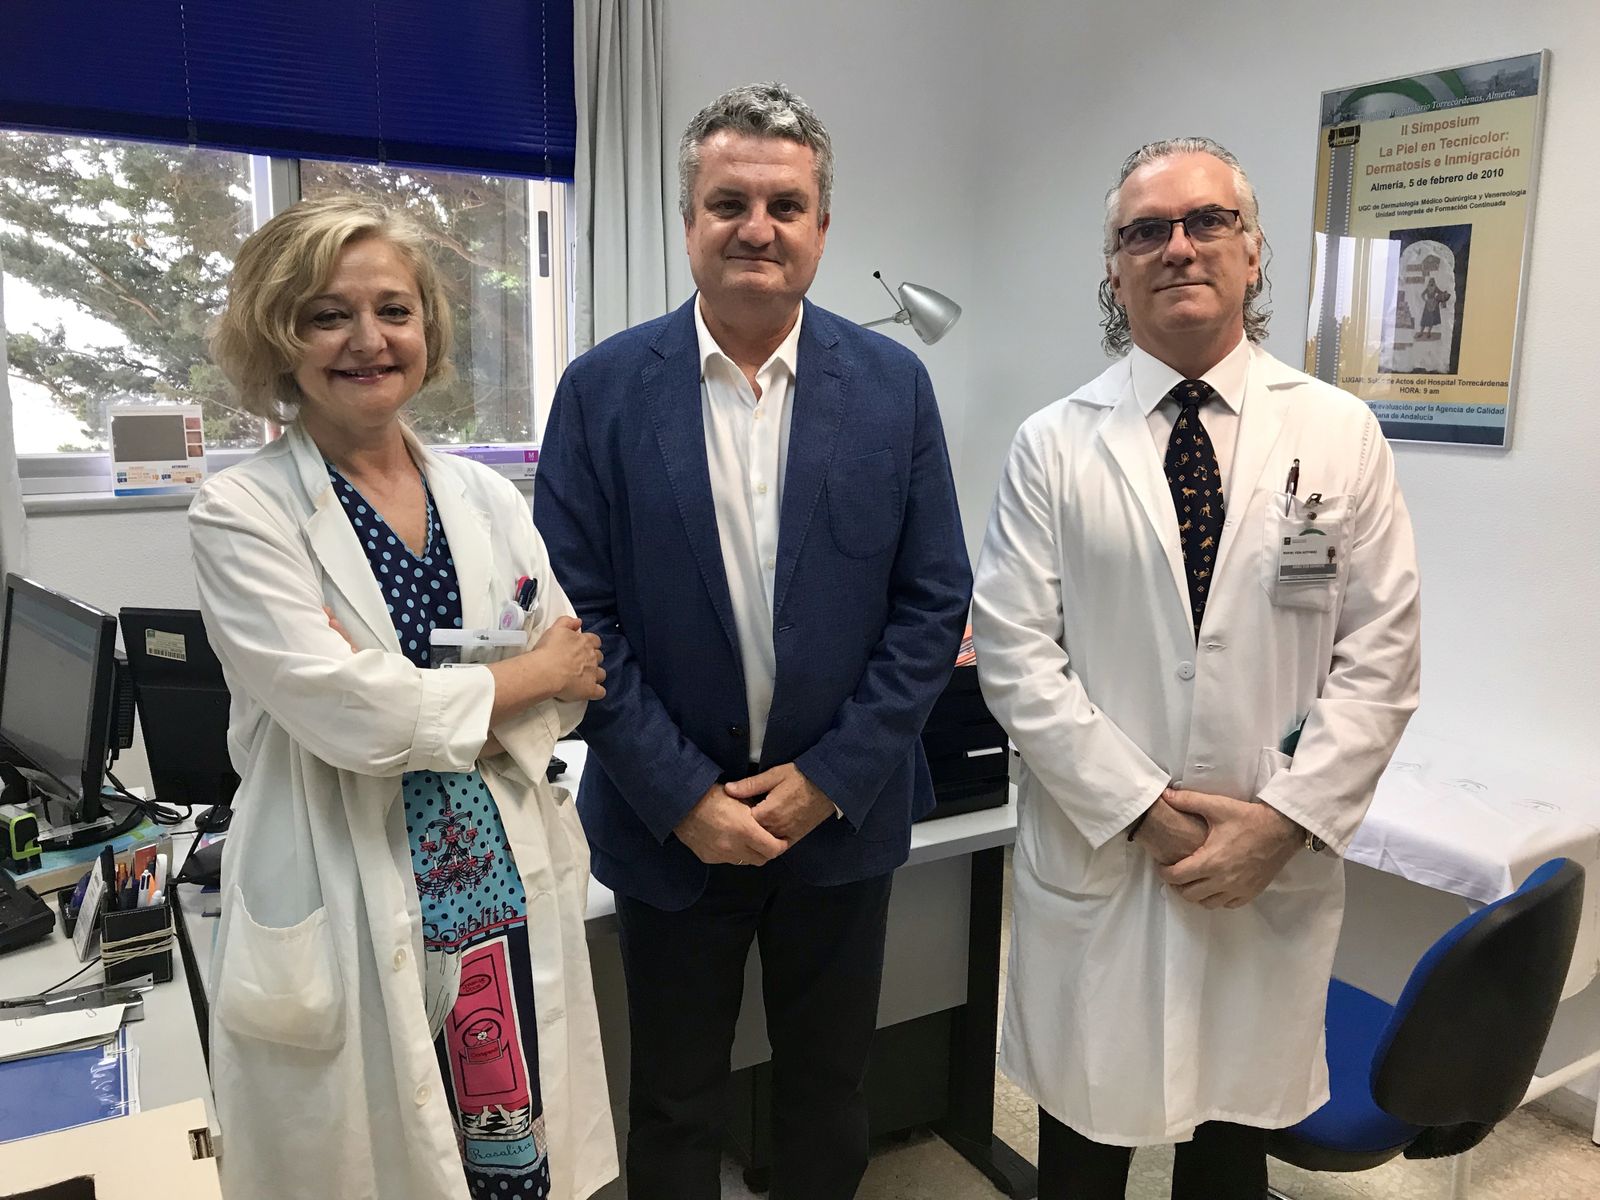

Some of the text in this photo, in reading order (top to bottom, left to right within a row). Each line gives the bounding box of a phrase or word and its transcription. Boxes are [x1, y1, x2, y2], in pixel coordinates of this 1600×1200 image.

[1485, 89, 1516, 101] Almería
[1400, 116, 1480, 136] II Simposium
[1379, 131, 1509, 158] La Piel en Tecnicolor:
[1366, 146, 1520, 176] Dermatosis e Inmigración
[1370, 168, 1504, 192] Almería, 5 de febrero de 2010
[1375, 210, 1396, 218] Unidad
[1397, 208, 1424, 216] Integrada
[1434, 204, 1468, 212] Formación
[1469, 200, 1506, 209] Continuada
[1421, 197, 1443, 206] Médico
[1458, 379, 1509, 387] Torrecárdenas
[1378, 403, 1413, 411] evaluación
[1435, 405, 1463, 413] Agencia
[1476, 406, 1505, 415] Calidad
[1400, 412, 1434, 420] Andalucía
